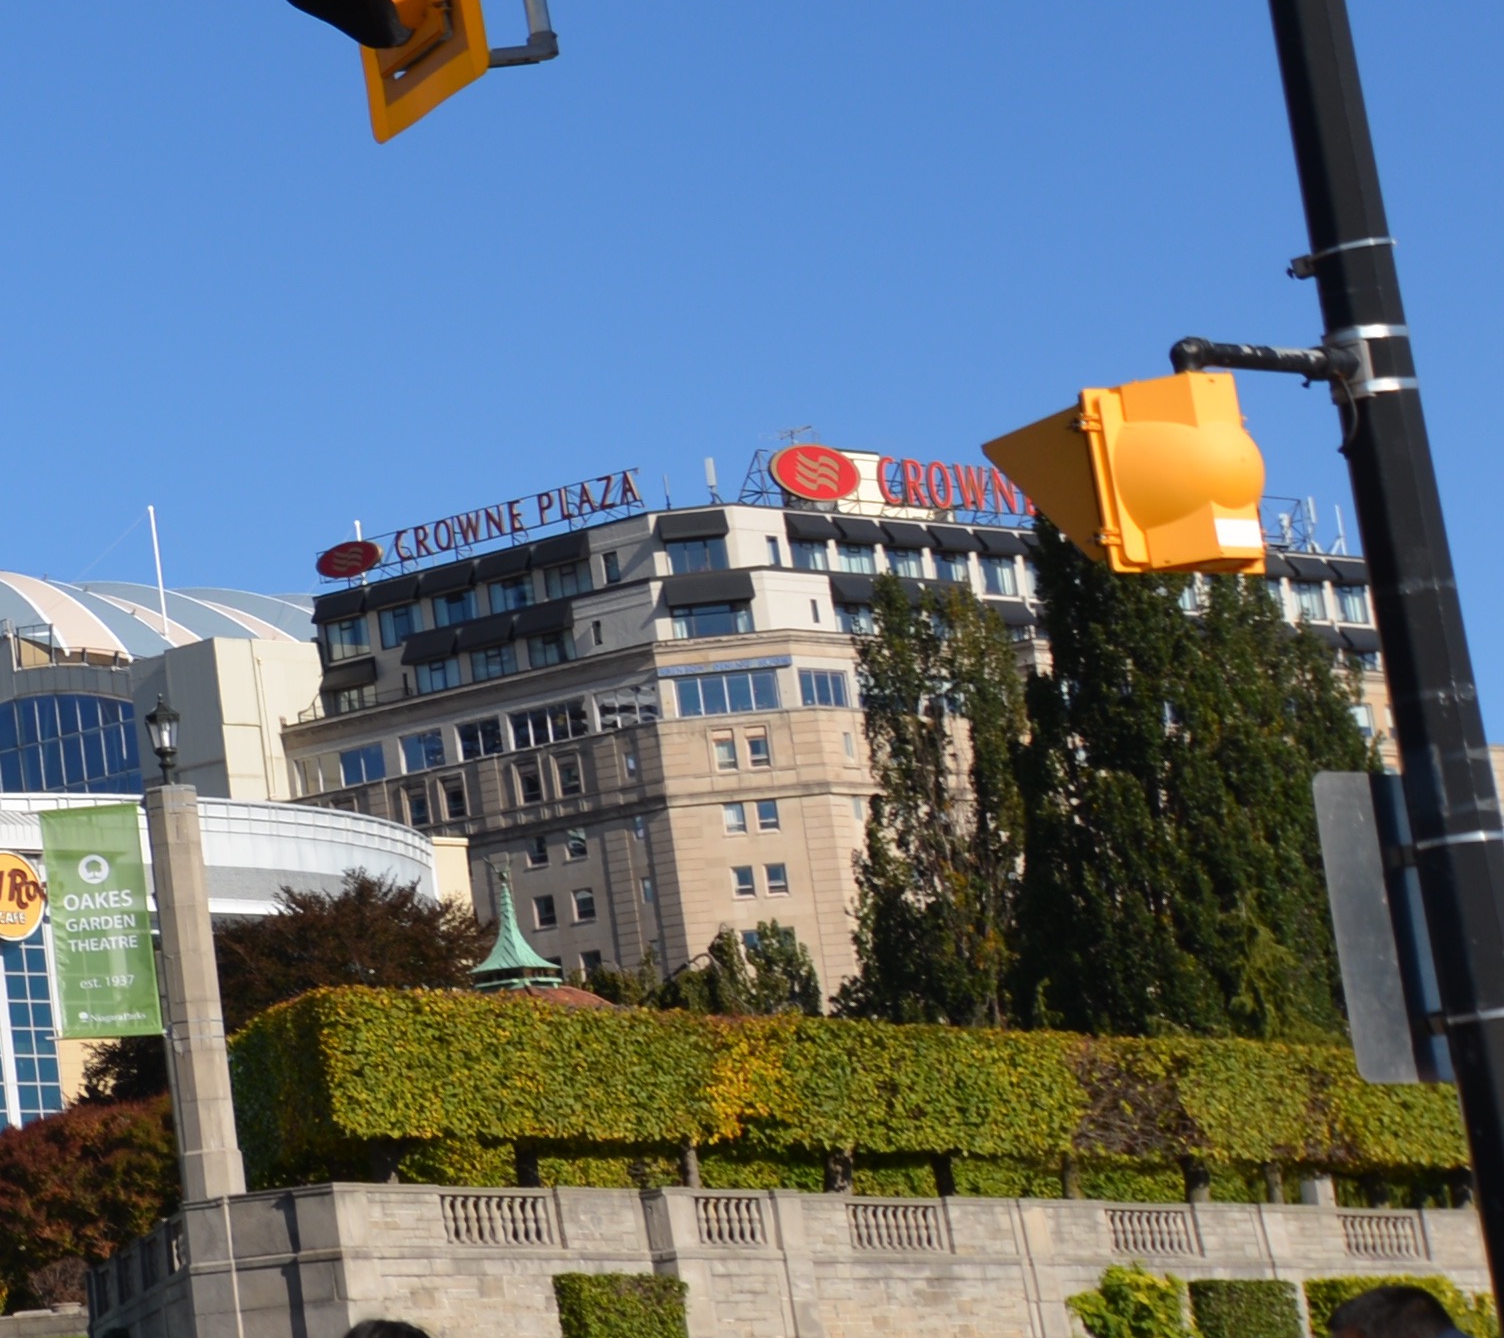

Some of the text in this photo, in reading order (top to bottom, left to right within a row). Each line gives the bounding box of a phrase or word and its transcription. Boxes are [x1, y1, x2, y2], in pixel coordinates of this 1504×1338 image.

[394, 469, 641, 561] CROWNE PLAZA
[63, 889, 134, 912] OAKES
[64, 913, 137, 933] GARDEN
[67, 934, 139, 953] THEATRE
[79, 973, 135, 990] est. 1937
